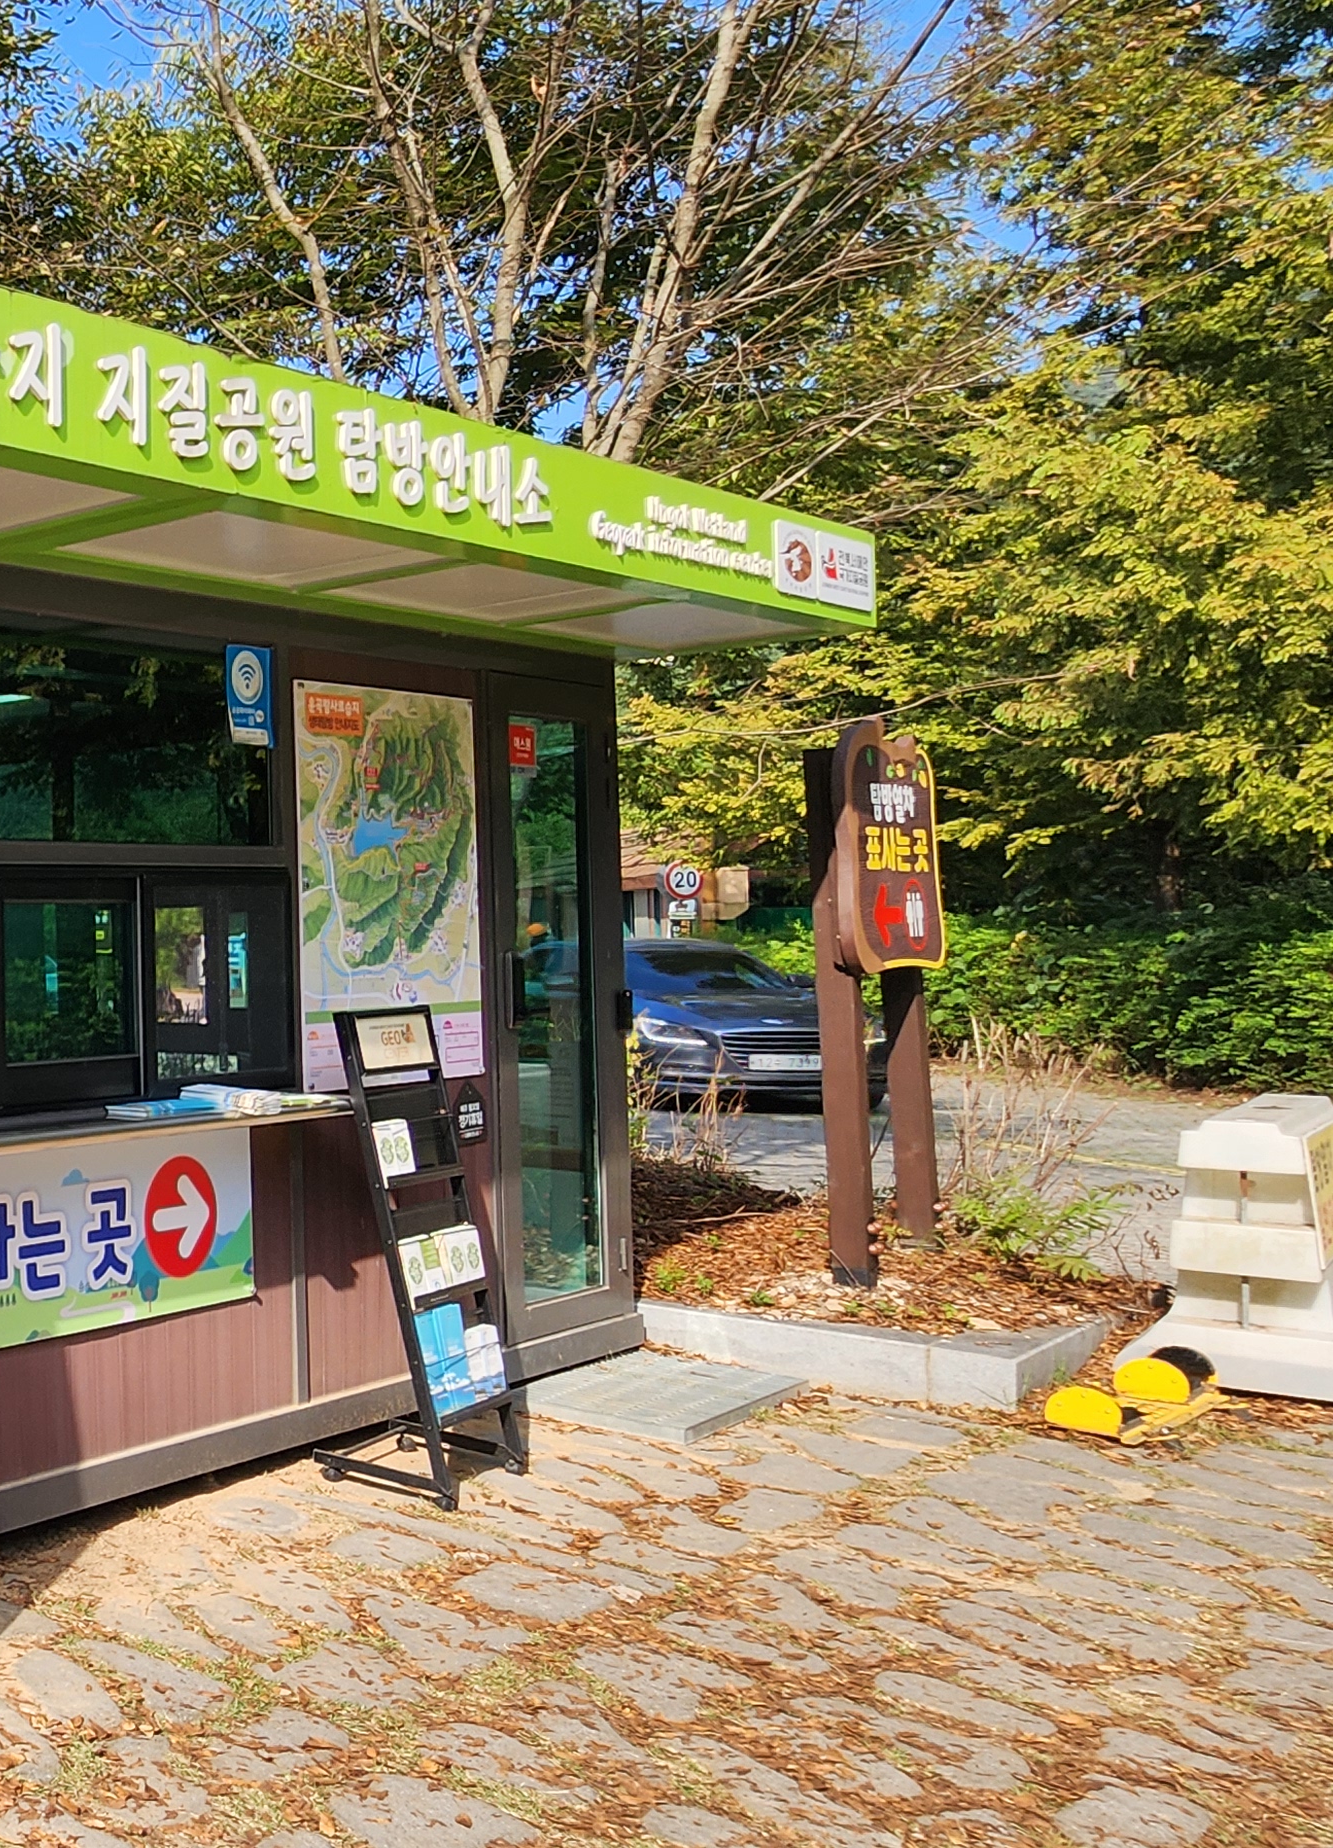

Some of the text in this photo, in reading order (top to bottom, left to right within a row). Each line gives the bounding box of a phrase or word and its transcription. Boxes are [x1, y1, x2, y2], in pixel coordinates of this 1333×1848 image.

[97, 345, 316, 482] 지질공원
[336, 407, 554, 528] 탐방안내소
[870, 783, 916, 824] 탐방열차
[674, 871, 696, 888] 20
[381, 1029, 401, 1046] GEO
[87, 1187, 132, 1281] 곳
